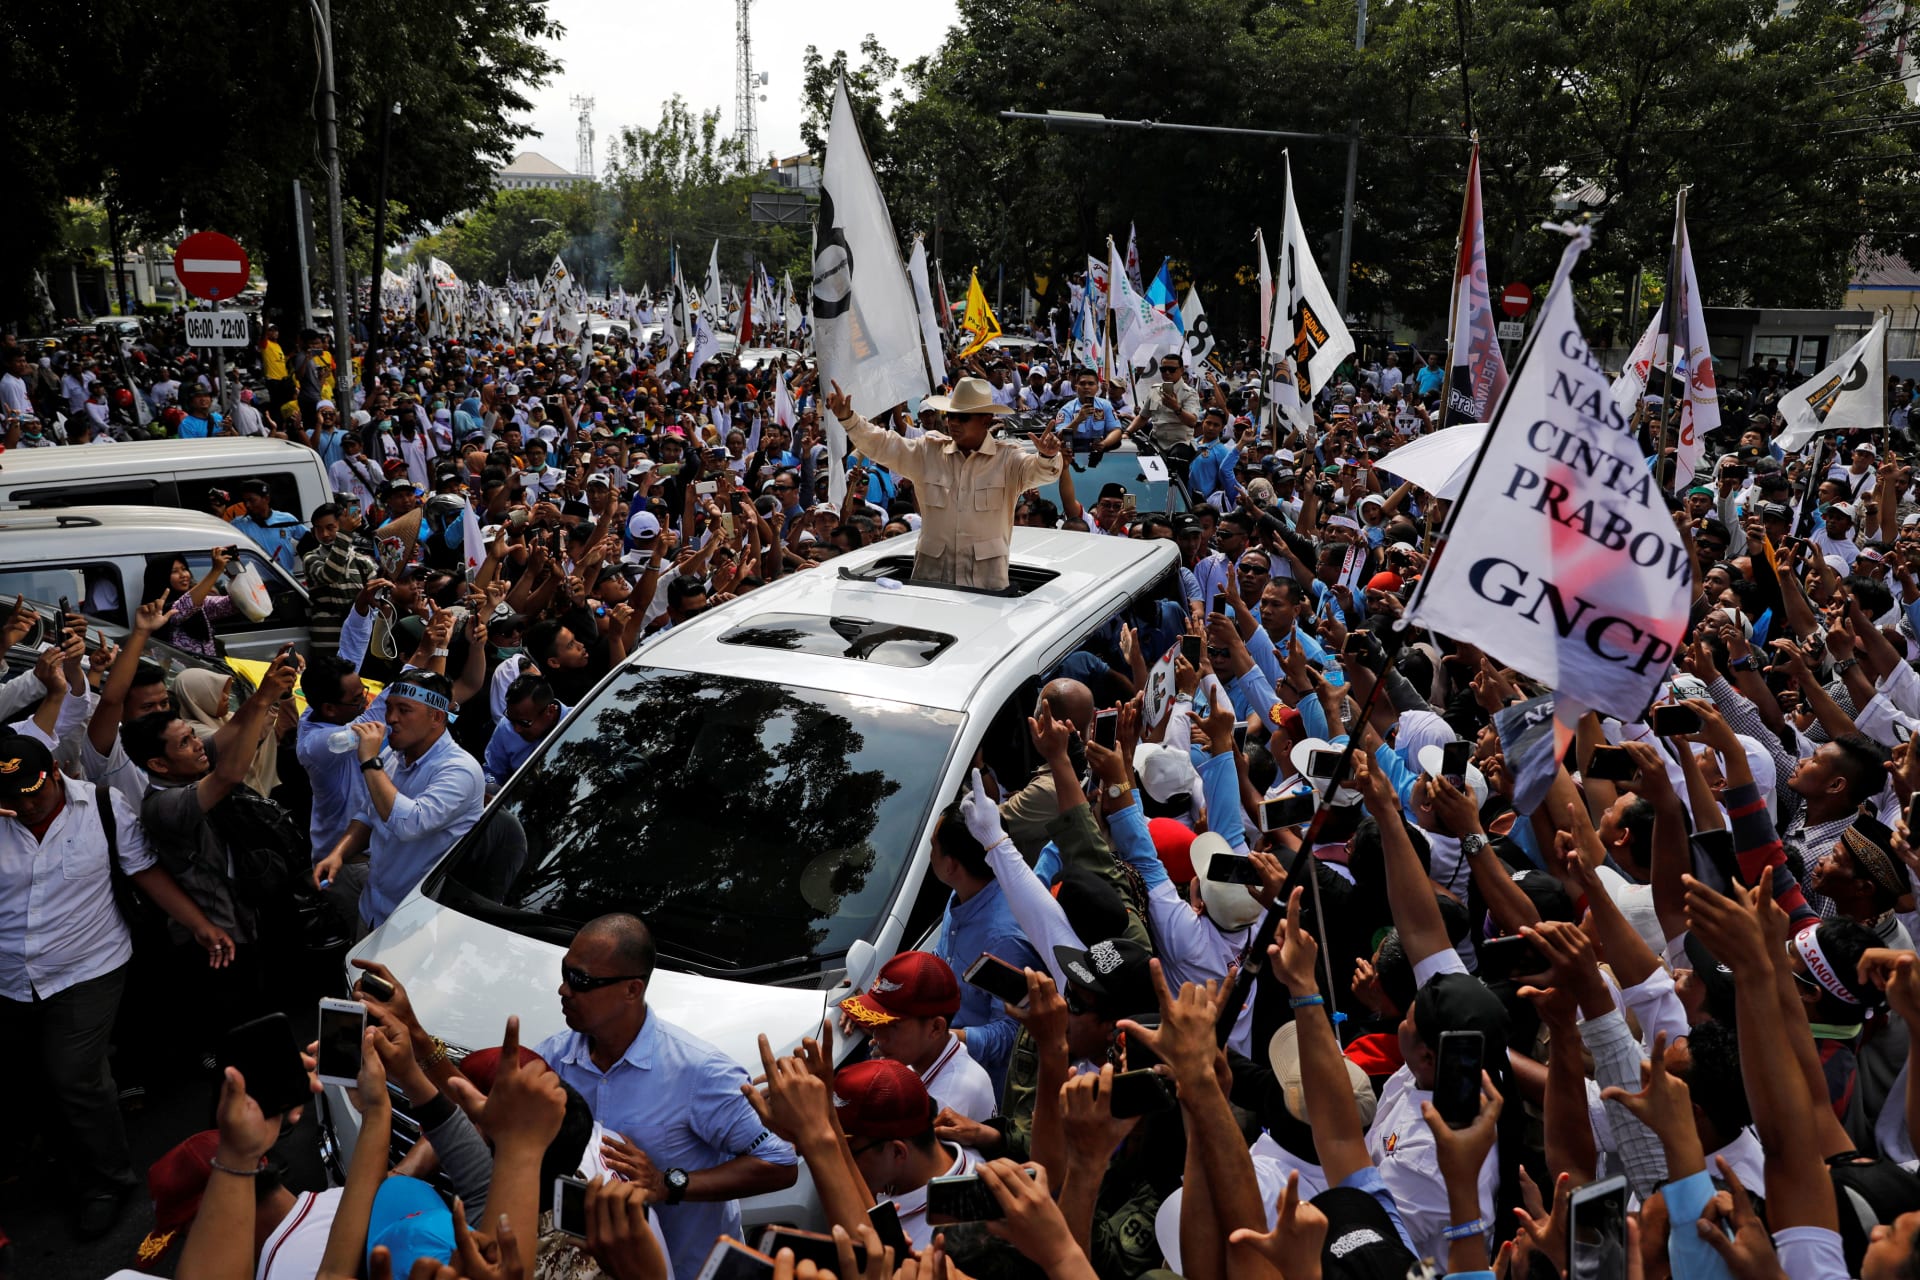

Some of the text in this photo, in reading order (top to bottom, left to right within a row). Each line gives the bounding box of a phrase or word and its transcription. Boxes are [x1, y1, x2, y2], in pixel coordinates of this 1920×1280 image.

[188, 318, 213, 338] 06:00
[221, 319, 246, 339] 22:00
[1548, 370, 1634, 439] NAS
[1149, 460, 1159, 471] 4
[1527, 420, 1651, 508] CINTA
[1469, 557, 1673, 677] GNCP
